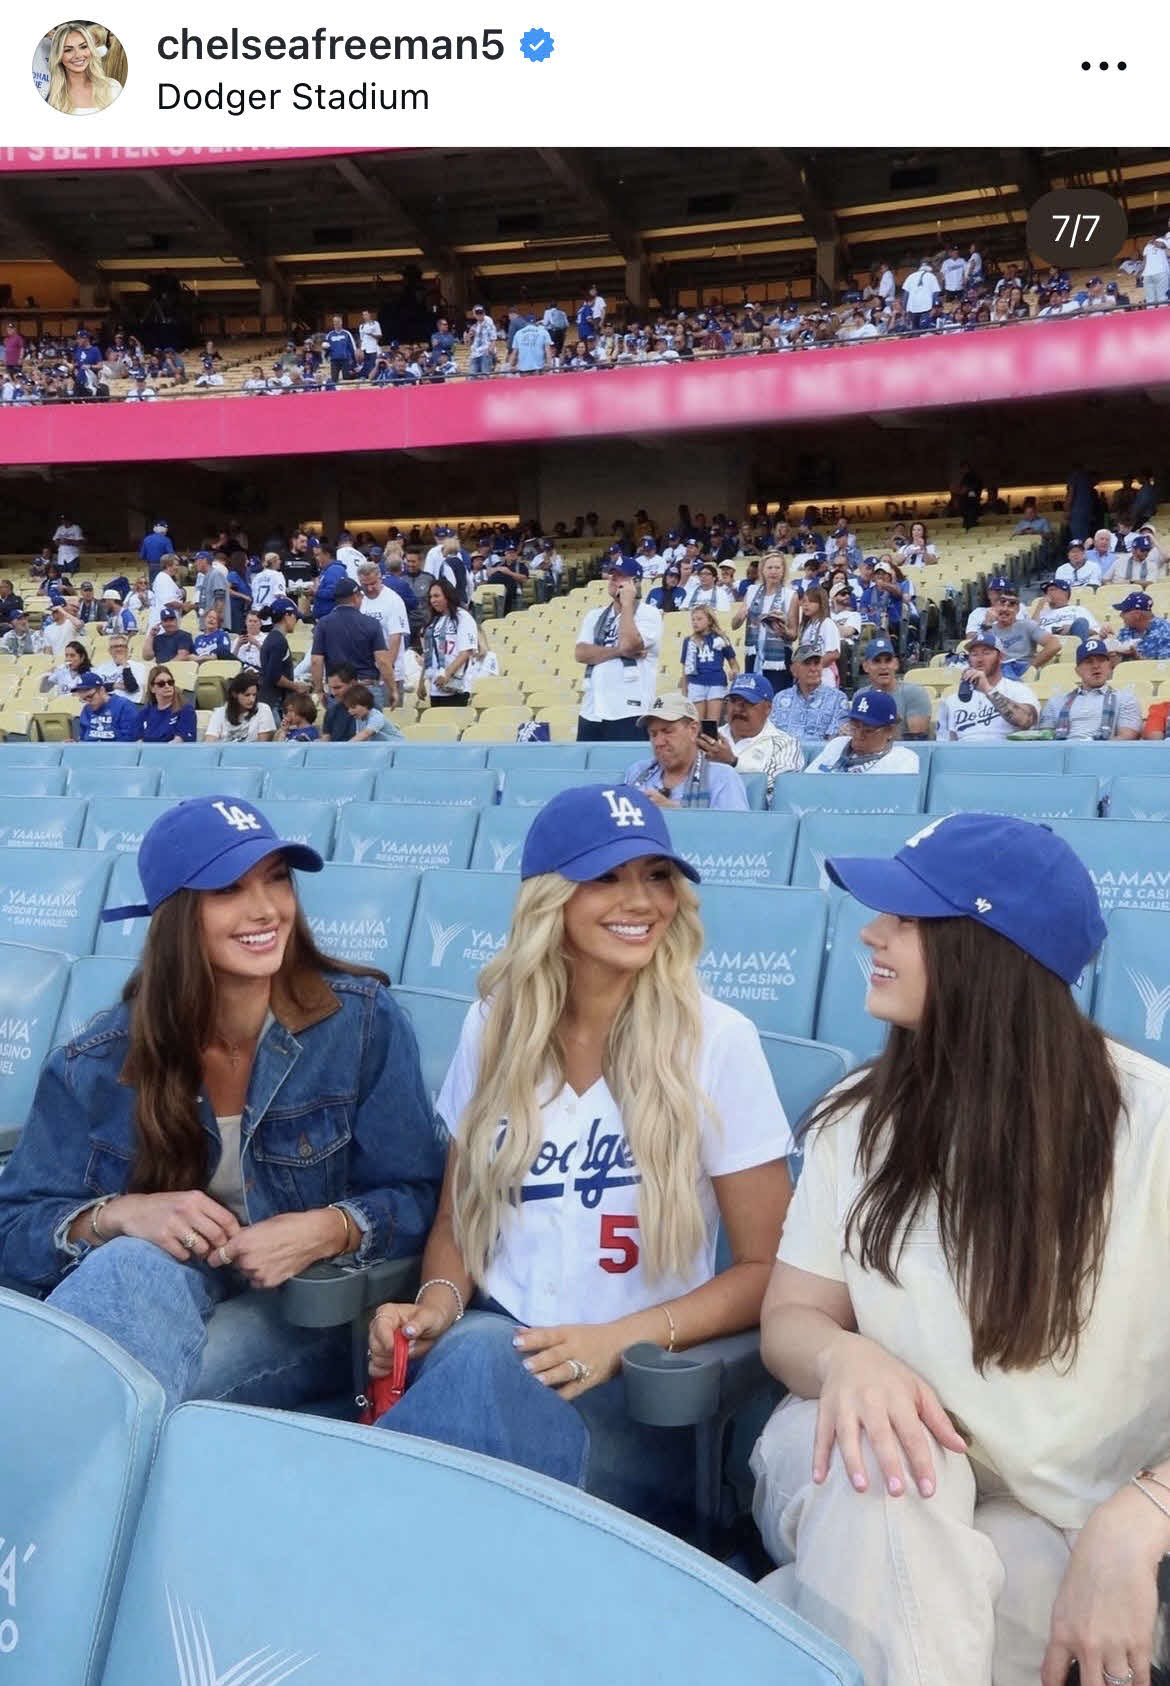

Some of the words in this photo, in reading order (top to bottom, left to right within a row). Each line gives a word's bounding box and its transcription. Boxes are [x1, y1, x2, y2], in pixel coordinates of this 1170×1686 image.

[211, 801, 262, 832] LA
[601, 790, 646, 827] LA
[1136, 887, 1169, 899] CASI
[701, 947, 797, 971] AMAVA'
[737, 972, 795, 986] CASINO
[598, 1213, 642, 1275] 5
